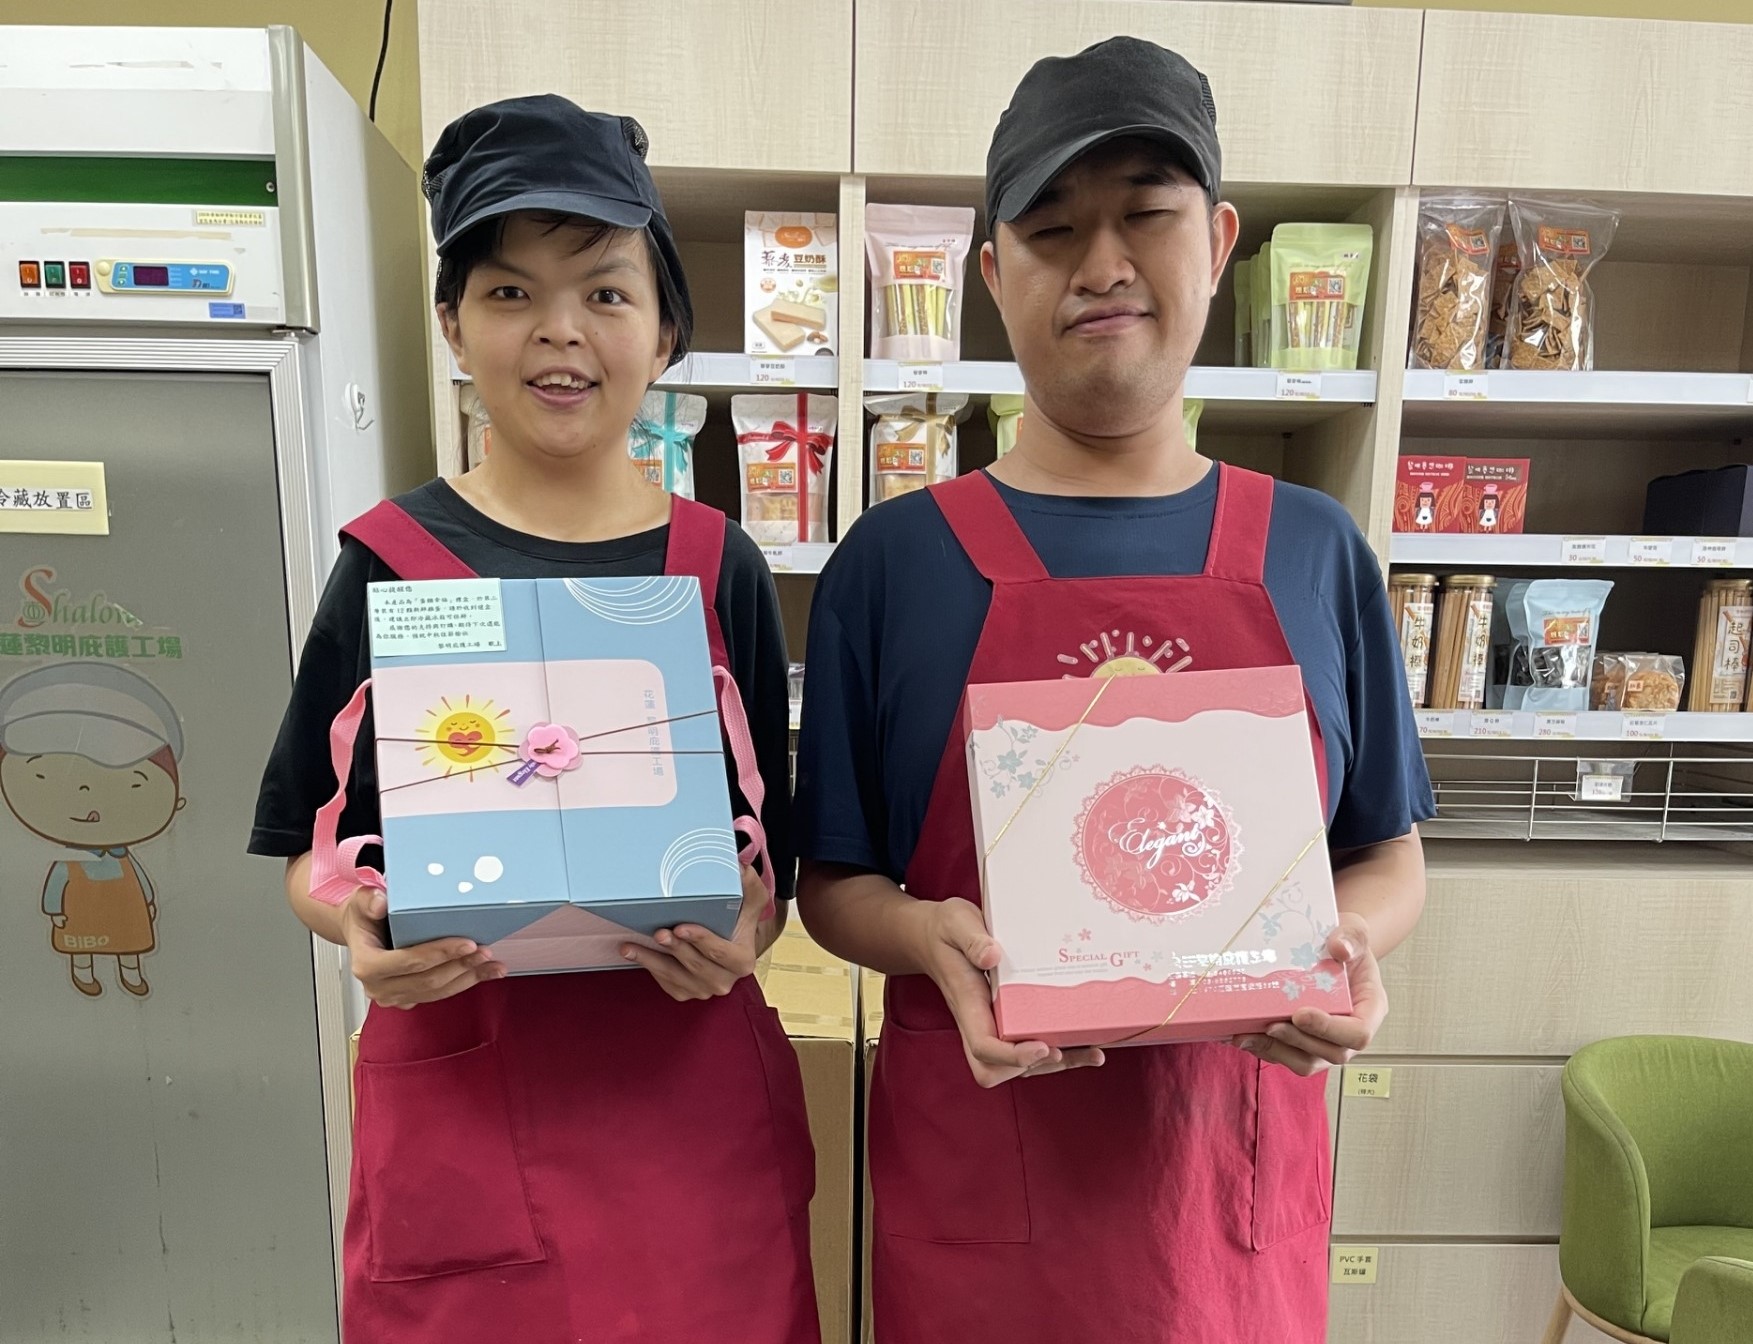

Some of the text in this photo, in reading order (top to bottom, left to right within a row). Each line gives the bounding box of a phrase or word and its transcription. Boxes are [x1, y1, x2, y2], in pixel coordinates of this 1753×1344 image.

[903, 380, 916, 388] 120
[0, 488, 92, 510] 冷藏放置區
[0, 632, 183, 659] 蓮黎明庇護工場
[1723, 621, 1744, 672] 起司棒
[1474, 727, 1487, 735] 210
[1538, 728, 1551, 736] 280
[1108, 817, 1206, 870] Elegant
[1357, 1073, 1378, 1083] 花袋
[1339, 1255, 1355, 1263] PVC
